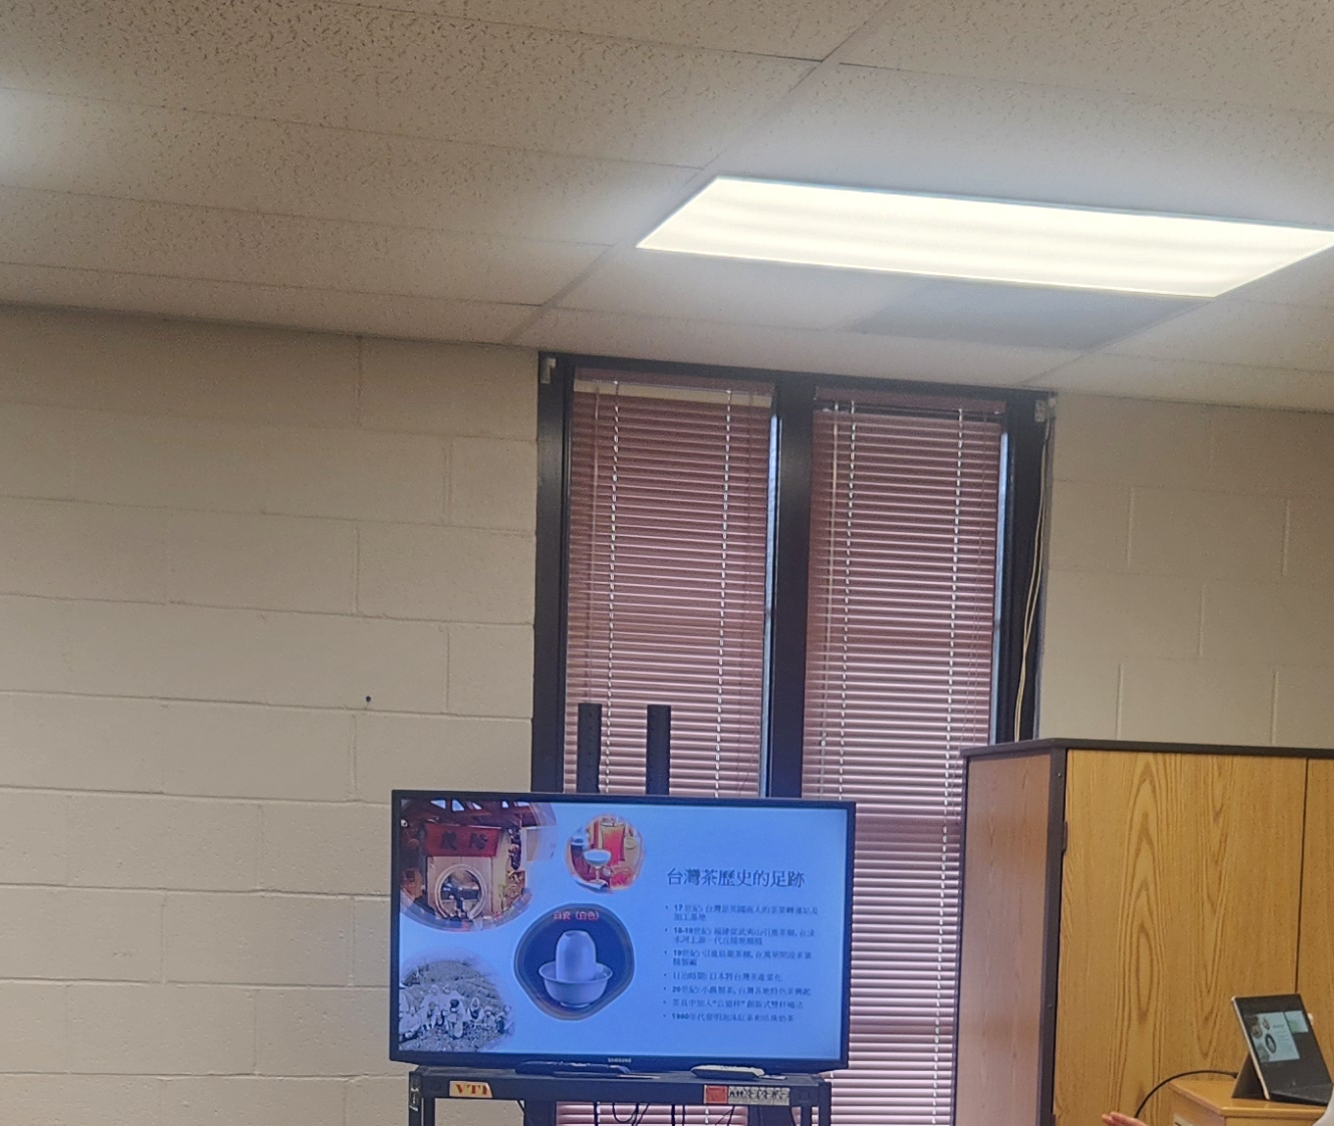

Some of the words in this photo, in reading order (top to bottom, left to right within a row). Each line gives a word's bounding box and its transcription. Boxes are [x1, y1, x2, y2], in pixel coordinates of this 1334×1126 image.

[667, 867, 805, 888] 台灣茶歷史的足跡
